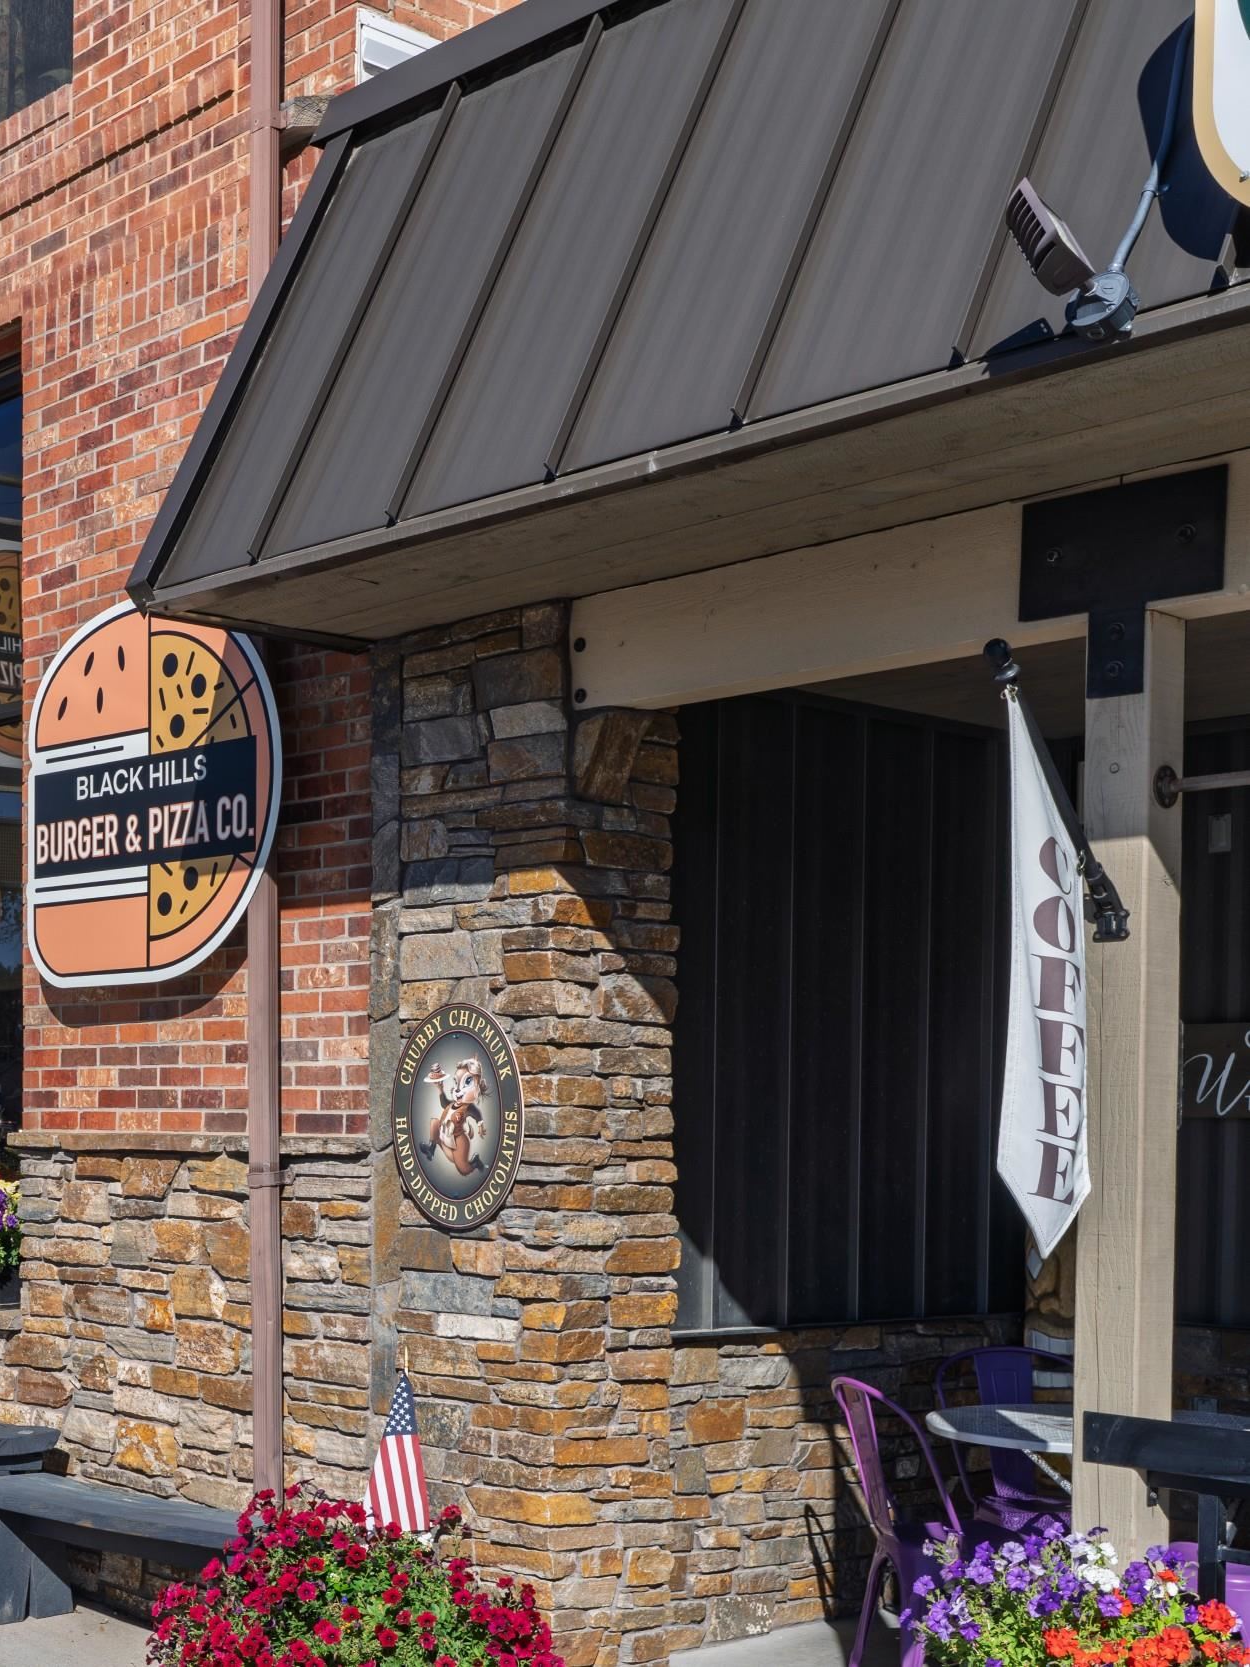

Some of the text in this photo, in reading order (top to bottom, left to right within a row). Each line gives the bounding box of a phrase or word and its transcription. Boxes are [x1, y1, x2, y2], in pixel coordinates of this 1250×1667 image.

[76, 754, 207, 801] BLACK HILLS
[36, 793, 255, 865] BURGER & PIZZA CO.
[400, 1009, 513, 1085] CHUBBY CHIPMUNK
[1027, 836, 1084, 1205] COFFEE
[395, 1116, 458, 1221] HAND-DIPPED
[464, 1110, 518, 1220] CHOCOLATES
